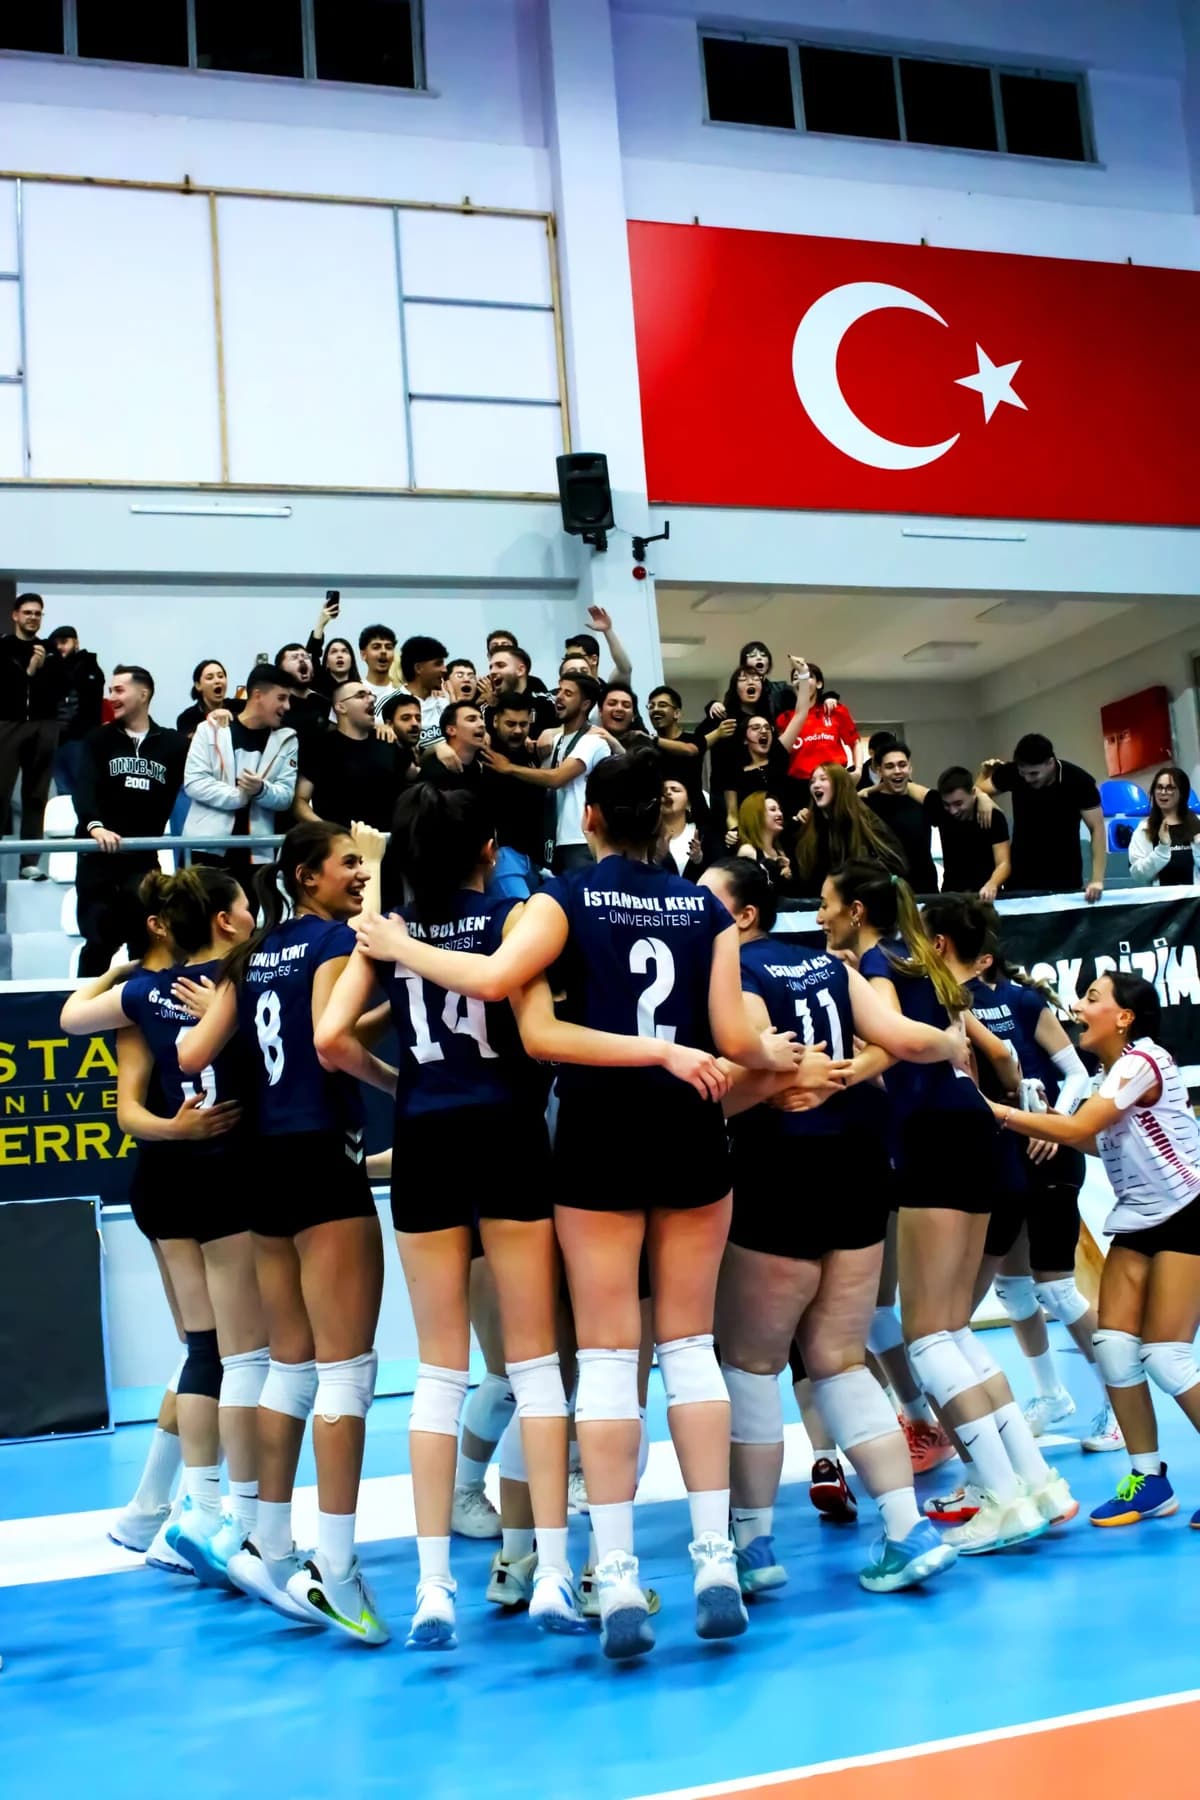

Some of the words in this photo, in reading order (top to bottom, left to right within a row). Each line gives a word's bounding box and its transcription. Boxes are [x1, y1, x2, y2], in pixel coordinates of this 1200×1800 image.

[124, 776, 150, 790] 2001
[583, 888, 663, 912] İSTANBUL
[665, 896, 705, 911] KENT
[609, 910, 690, 927] ÜNİVERSİTESİ
[394, 960, 499, 1064] 14
[629, 936, 677, 1044] 2
[795, 988, 844, 1061] 11
[254, 989, 285, 1086] 8
